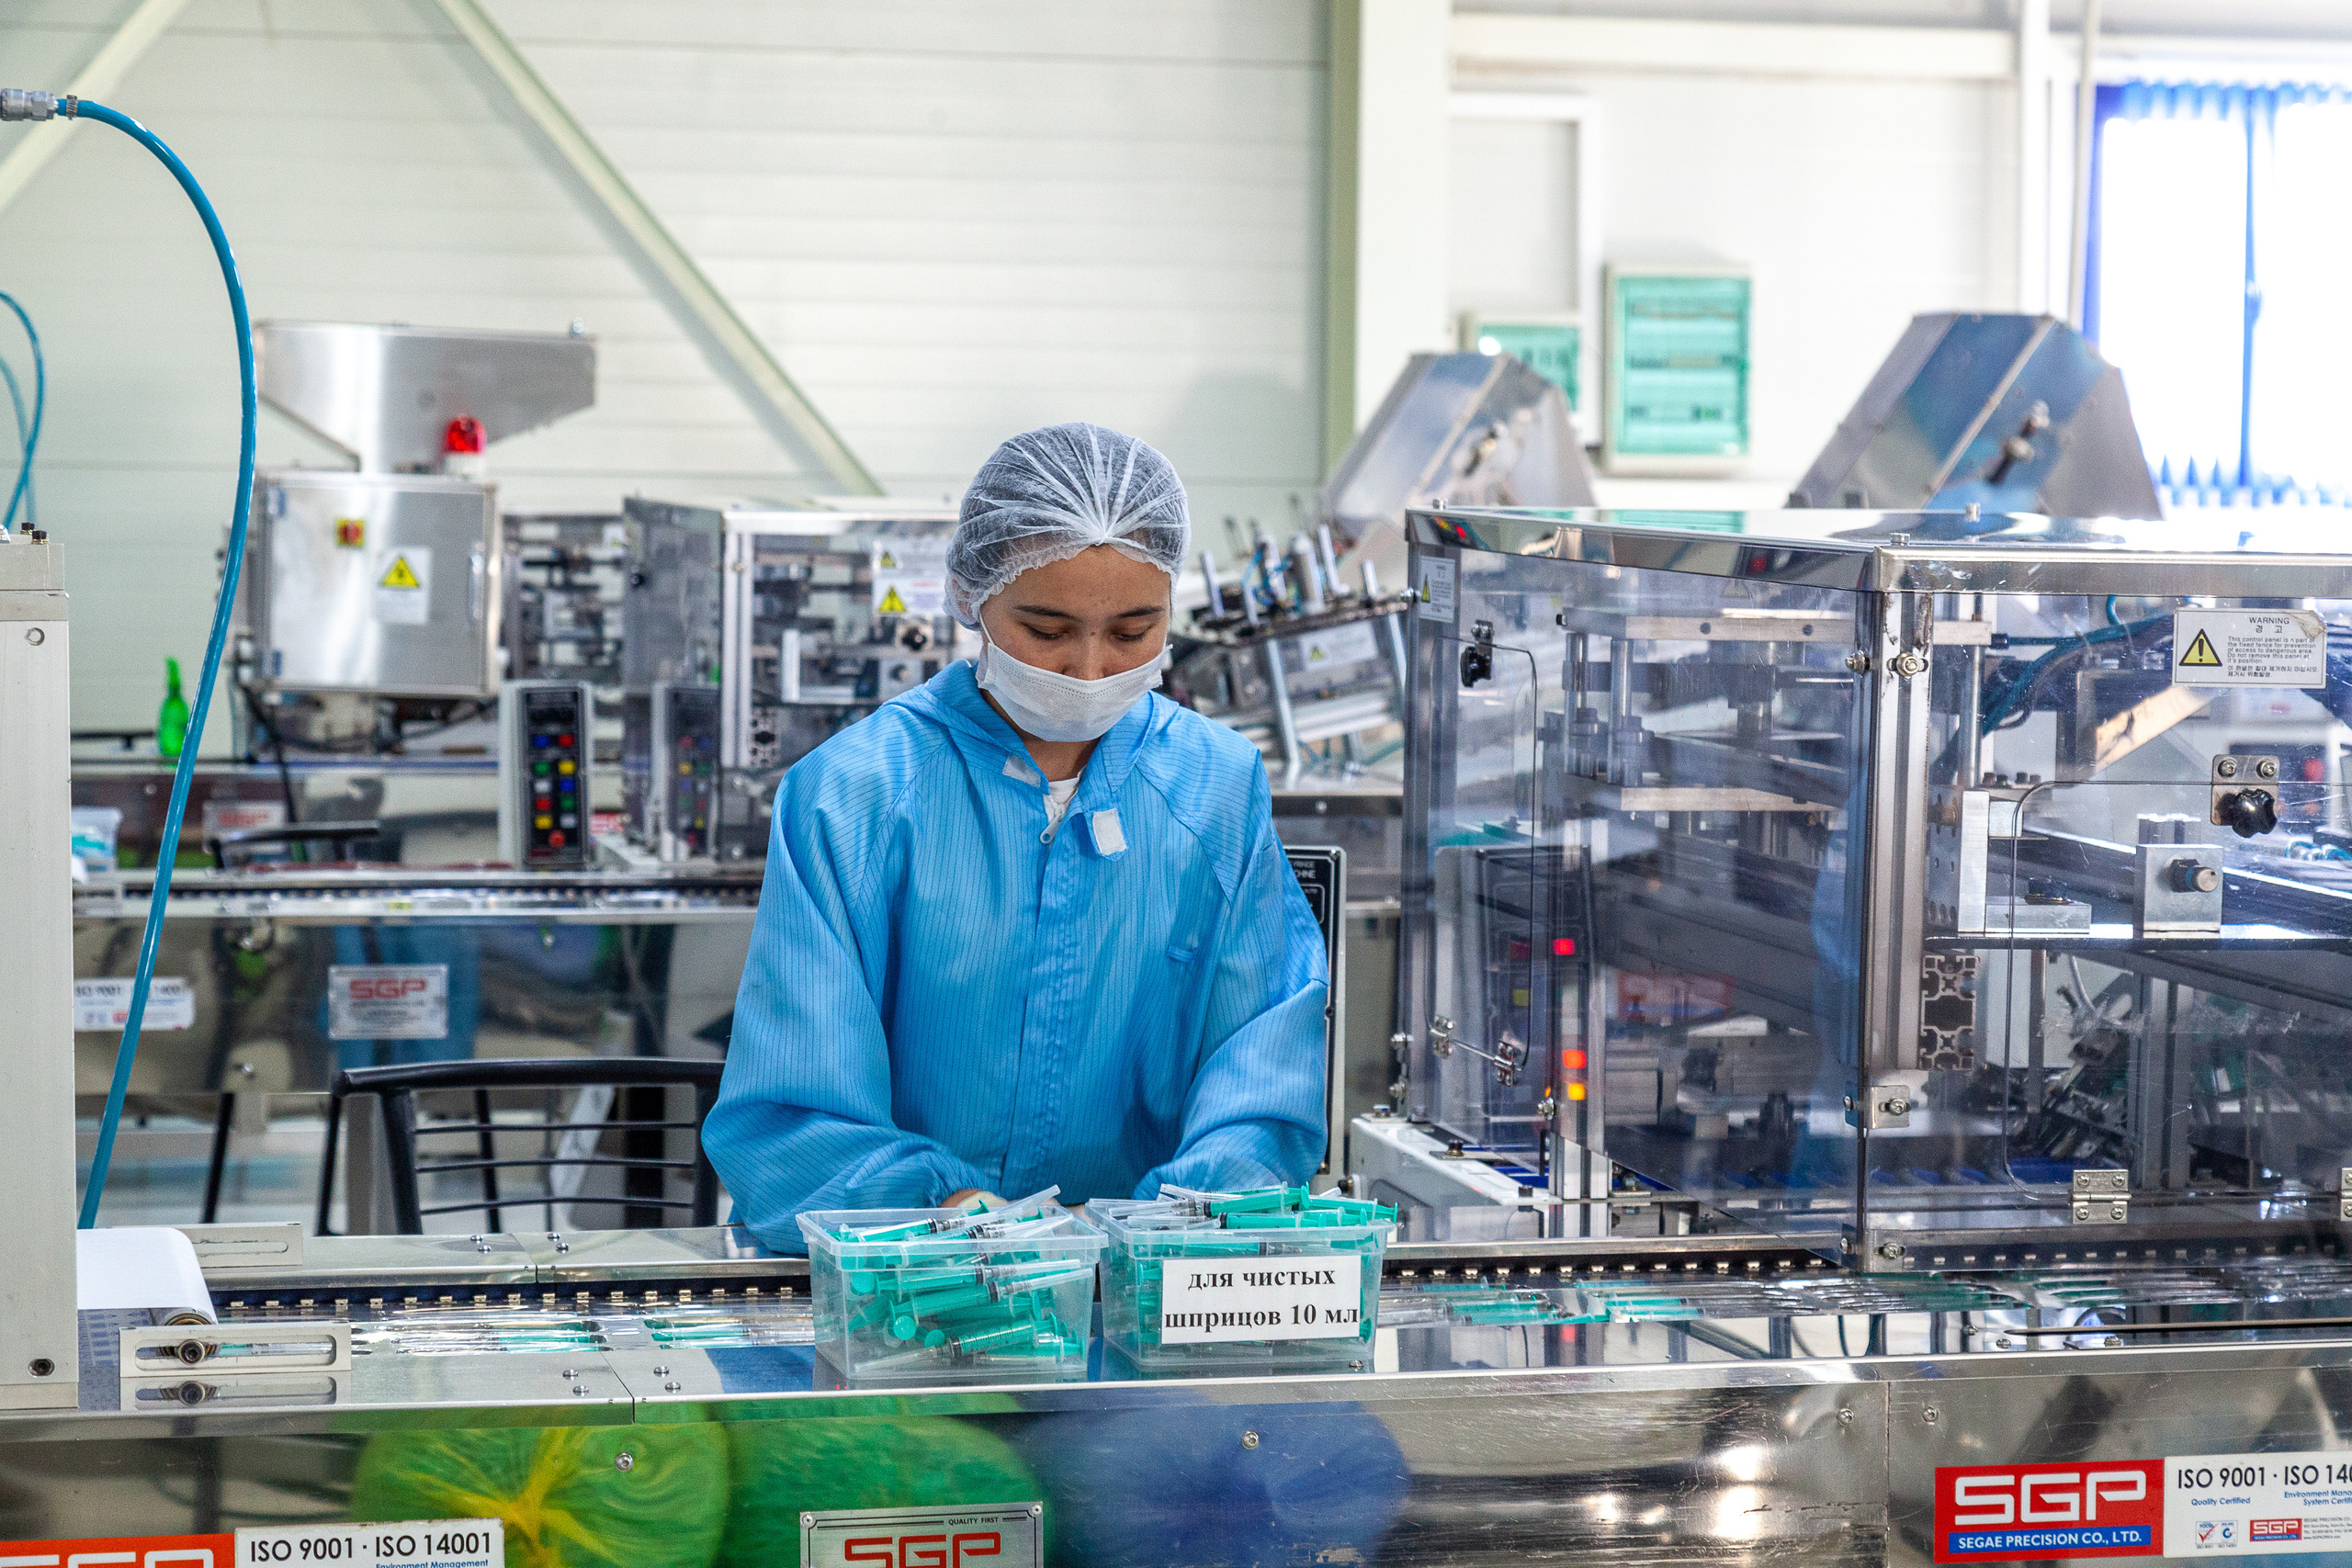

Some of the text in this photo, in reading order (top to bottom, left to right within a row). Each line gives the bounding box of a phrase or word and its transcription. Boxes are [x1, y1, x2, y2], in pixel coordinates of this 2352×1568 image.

[349, 978, 426, 999] SGP
[1187, 1269, 1336, 1291] для чистых
[1165, 1303, 1359, 1333] шприцов 10 мл
[2178, 1468, 2213, 1489] ISO
[2220, 1467, 2265, 1487] 9001
[2284, 1465, 2319, 1485] ISO
[1955, 1470, 2146, 1526] SGP
[2191, 1496, 2251, 1506] Quality Certified
[2284, 1490, 2329, 1498] Environment
[2303, 1498, 2329, 1506] System
[948, 1517, 978, 1526] QUALITY
[2254, 1520, 2299, 1534] SGP
[252, 1532, 491, 1562] ISO 9001 ISO 14001
[844, 1531, 1001, 1568] SGP
[1958, 1530, 2143, 1550] SEGAE PRECISION CO., LTD.
[431, 1559, 488, 1568] Management
